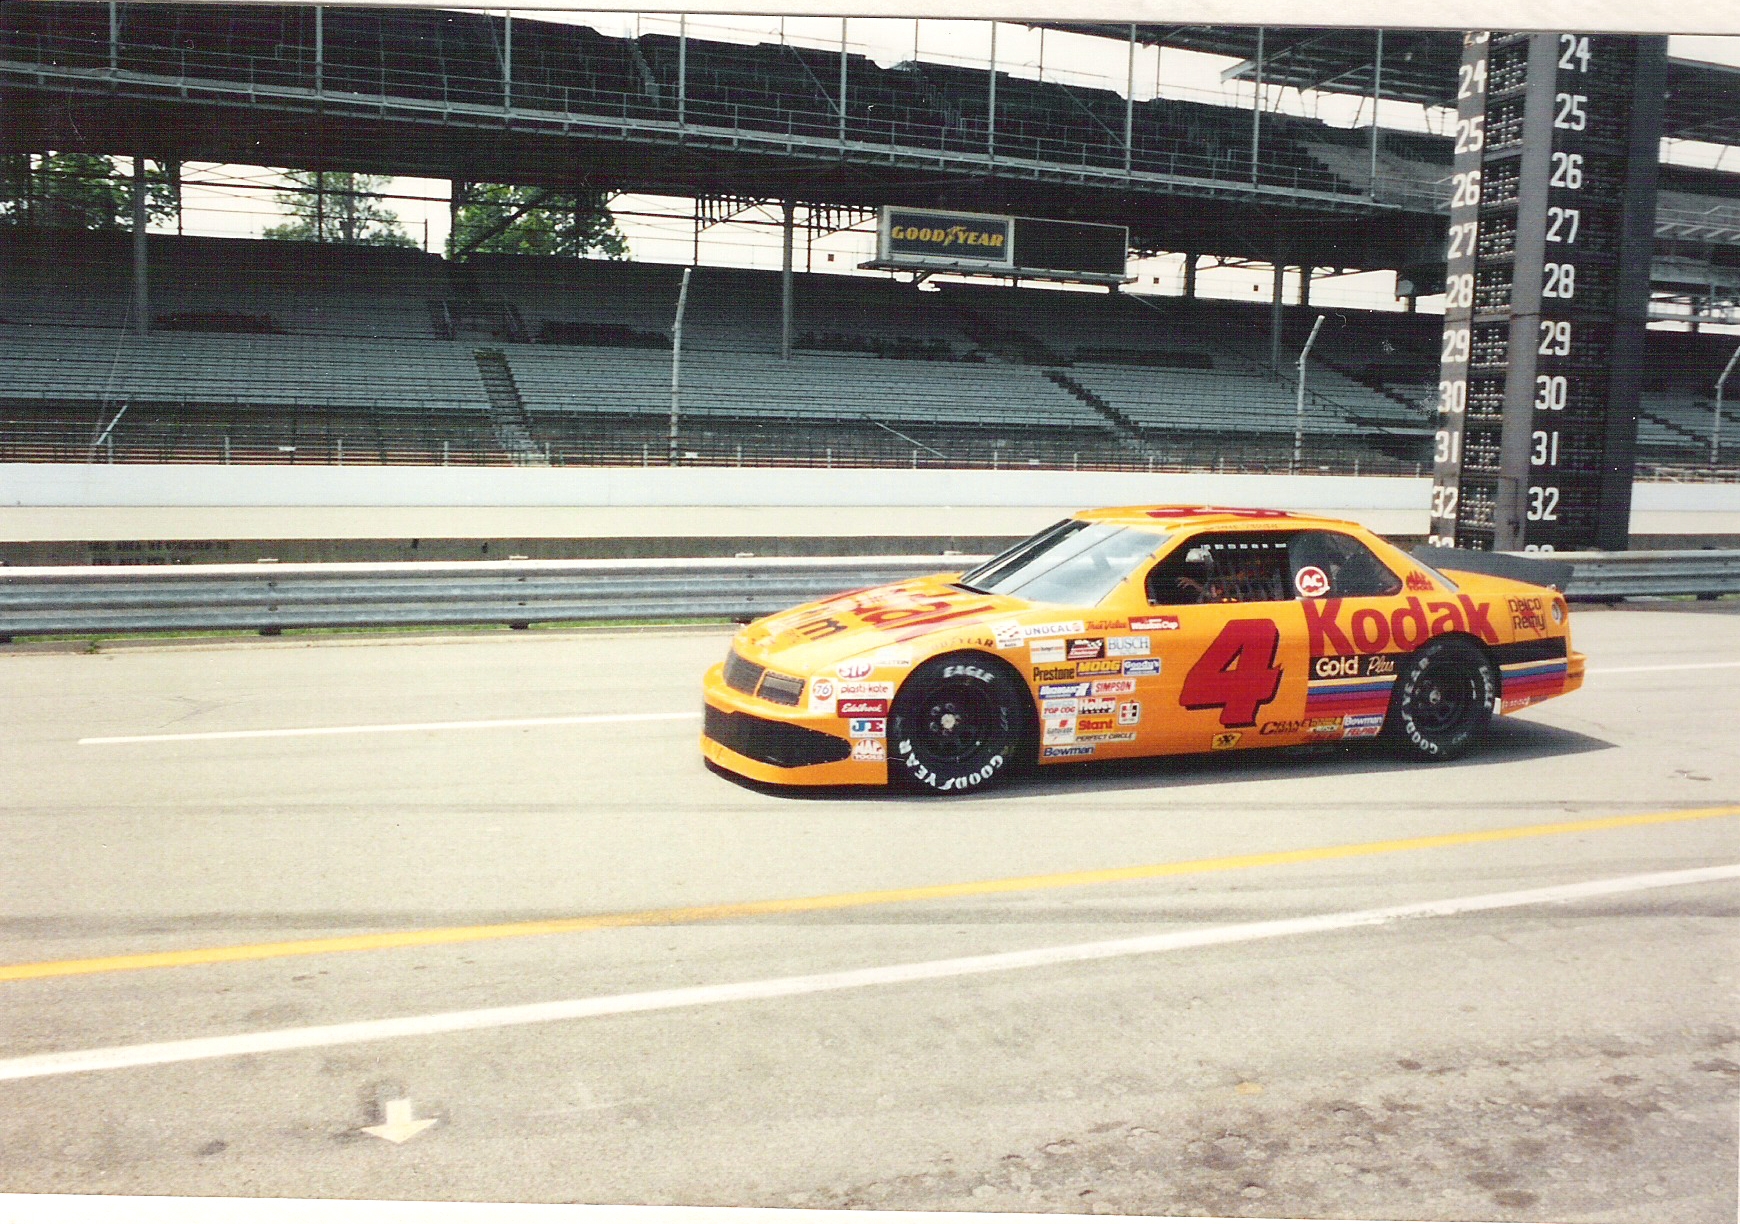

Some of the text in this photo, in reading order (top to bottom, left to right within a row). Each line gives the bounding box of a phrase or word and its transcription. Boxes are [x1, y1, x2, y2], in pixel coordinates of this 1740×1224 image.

[1559, 34, 1591, 72] 24
[1458, 60, 1487, 99] 24
[1554, 93, 1587, 130] 25
[1455, 116, 1484, 154] 25
[1550, 152, 1583, 189] 26
[1451, 171, 1481, 208] 26
[891, 226, 1004, 247] GOODYEAR
[1448, 222, 1477, 259] 27
[1546, 207, 1579, 243] 27
[1446, 274, 1473, 309] 28
[1543, 263, 1574, 298] 28
[1441, 328, 1470, 363] 29
[1538, 321, 1570, 356] 29
[1437, 380, 1466, 413] 30
[1535, 375, 1567, 410] 30
[1434, 431, 1459, 463] 31
[1531, 431, 1558, 465] 31
[1430, 486, 1458, 519] 32
[1527, 487, 1559, 520] 32
[1301, 574, 1323, 588] AC
[1508, 597, 1542, 612] Delco
[1024, 624, 1072, 636] UNOCAL
[1301, 594, 1499, 658] Kodak
[1514, 614, 1546, 631] Remy
[1108, 637, 1149, 650] BUSCH
[838, 662, 872, 679] STP
[943, 665, 995, 683] EAGLE
[1033, 667, 1075, 682] Prestone
[1077, 661, 1121, 672] MOOG
[1179, 618, 1284, 729] 4
[1316, 656, 1396, 677] Gold Plus
[816, 683, 830, 695] 76
[1095, 681, 1132, 692] SIMPSON
[851, 720, 884, 732] JE
[1060, 706, 1076, 714] COG
[1079, 719, 1114, 731] Stant
[1343, 715, 1384, 728] Bowman
[1043, 745, 1094, 757] Bowman
[1075, 732, 1133, 741] PERFECT CIRCLE
[899, 738, 1004, 791] GOODYEAR
